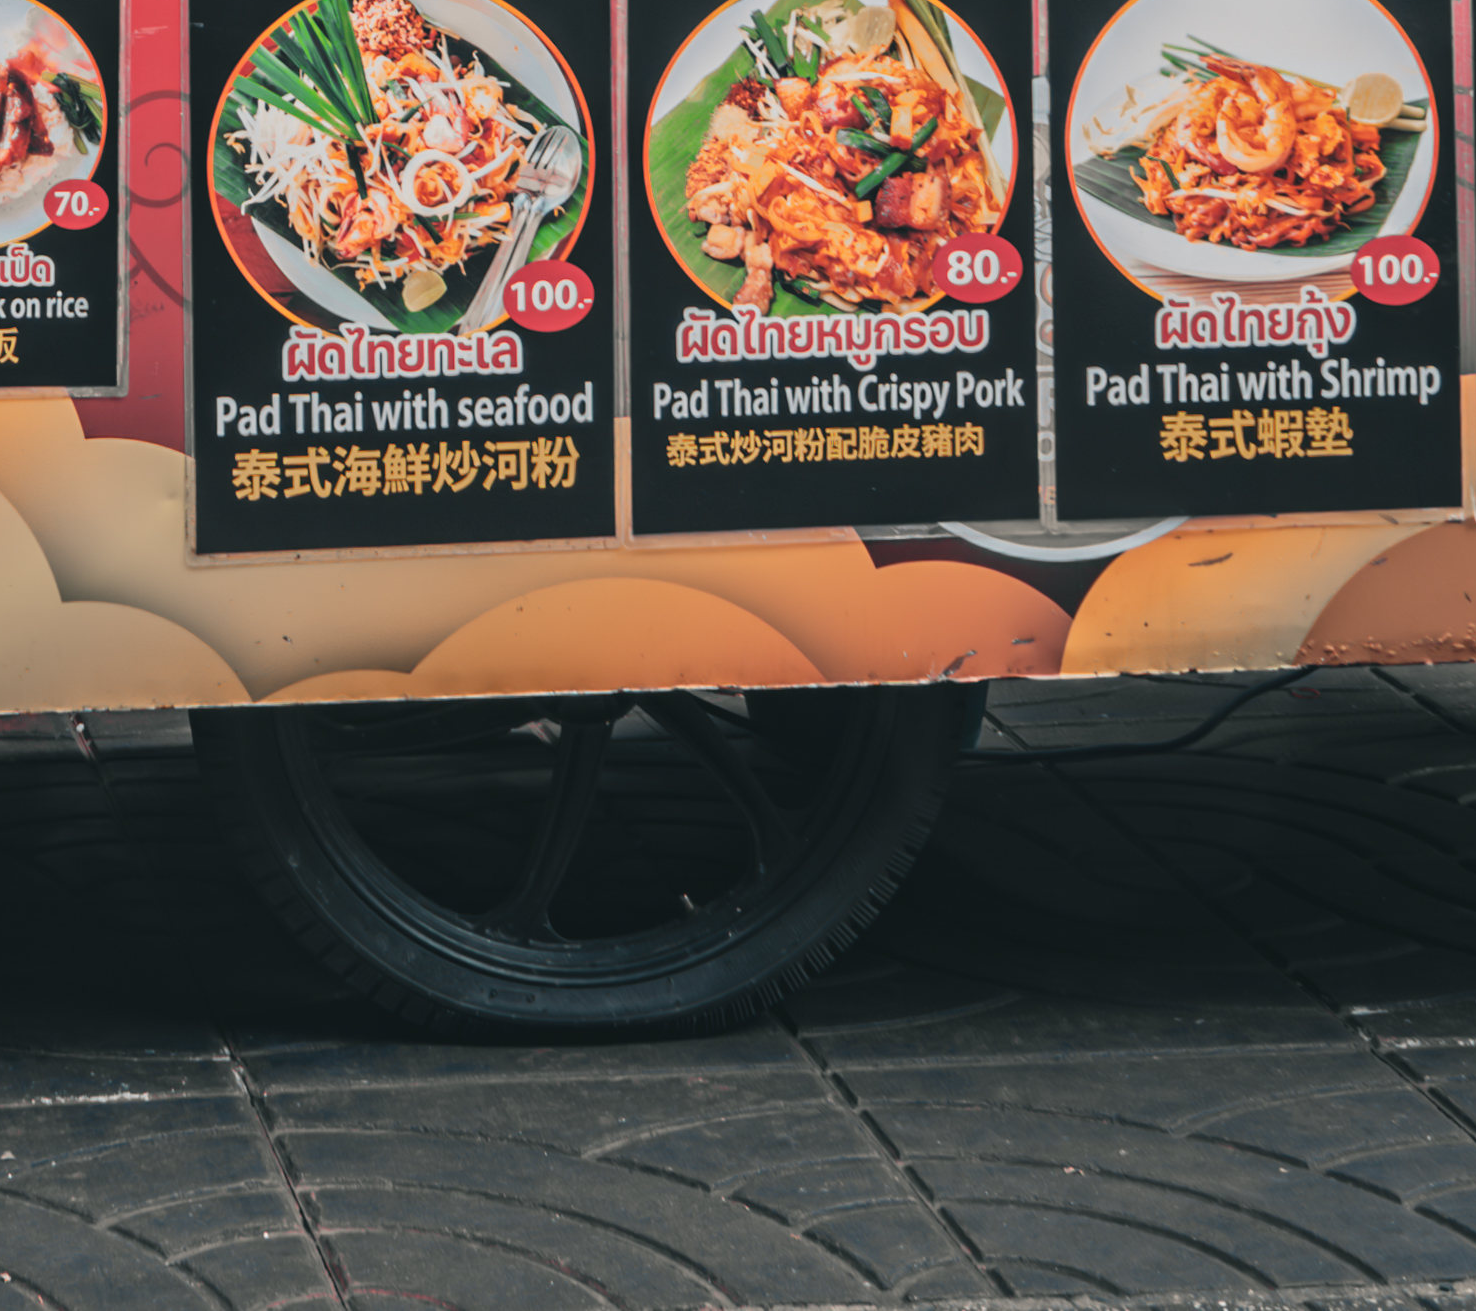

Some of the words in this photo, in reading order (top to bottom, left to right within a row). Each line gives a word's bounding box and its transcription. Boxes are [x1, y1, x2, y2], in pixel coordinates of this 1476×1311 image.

[11, 298, 40, 318] on
[47, 291, 88, 318] rice
[282, 323, 524, 382] ผัดไทยทะเล
[217, 393, 280, 436] Pad
[289, 391, 363, 434] Thai
[372, 388, 449, 430] with
[458, 381, 593, 427] seafood
[232, 437, 579, 501] 泰式海鮮炒河粉
